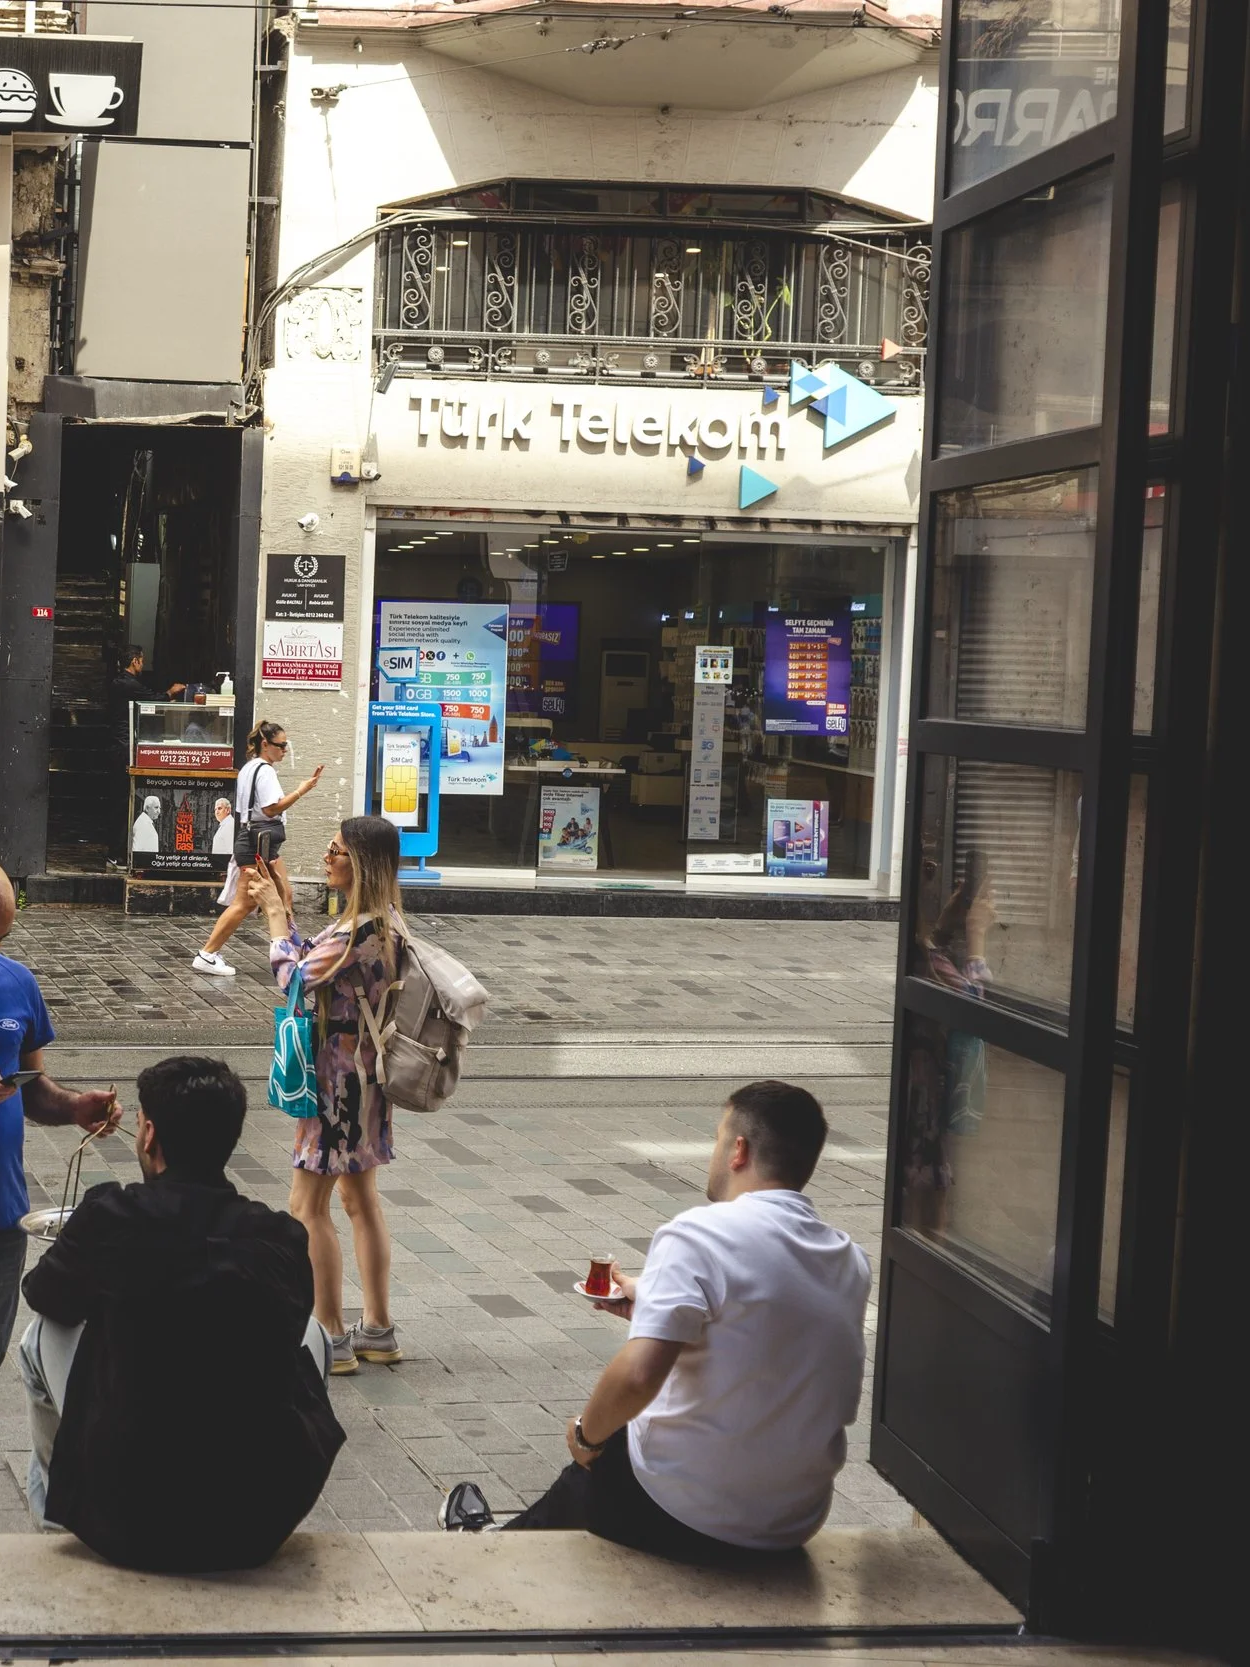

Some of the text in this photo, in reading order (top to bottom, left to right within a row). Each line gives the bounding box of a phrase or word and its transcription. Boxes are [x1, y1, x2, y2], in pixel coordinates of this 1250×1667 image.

[410, 391, 789, 451] Türk Telekom
[430, 614, 461, 622] kalitesiyle
[383, 656, 413, 670] eSIM
[282, 667, 306, 675] KÖFTE
[445, 673, 460, 681] 750
[471, 672, 486, 680] 750
[415, 688, 432, 699] GB
[826, 717, 846, 731] selfy
[160, 755, 177, 763] 0212
[178, 755, 190, 763] 251
[191, 756, 200, 764] 94
